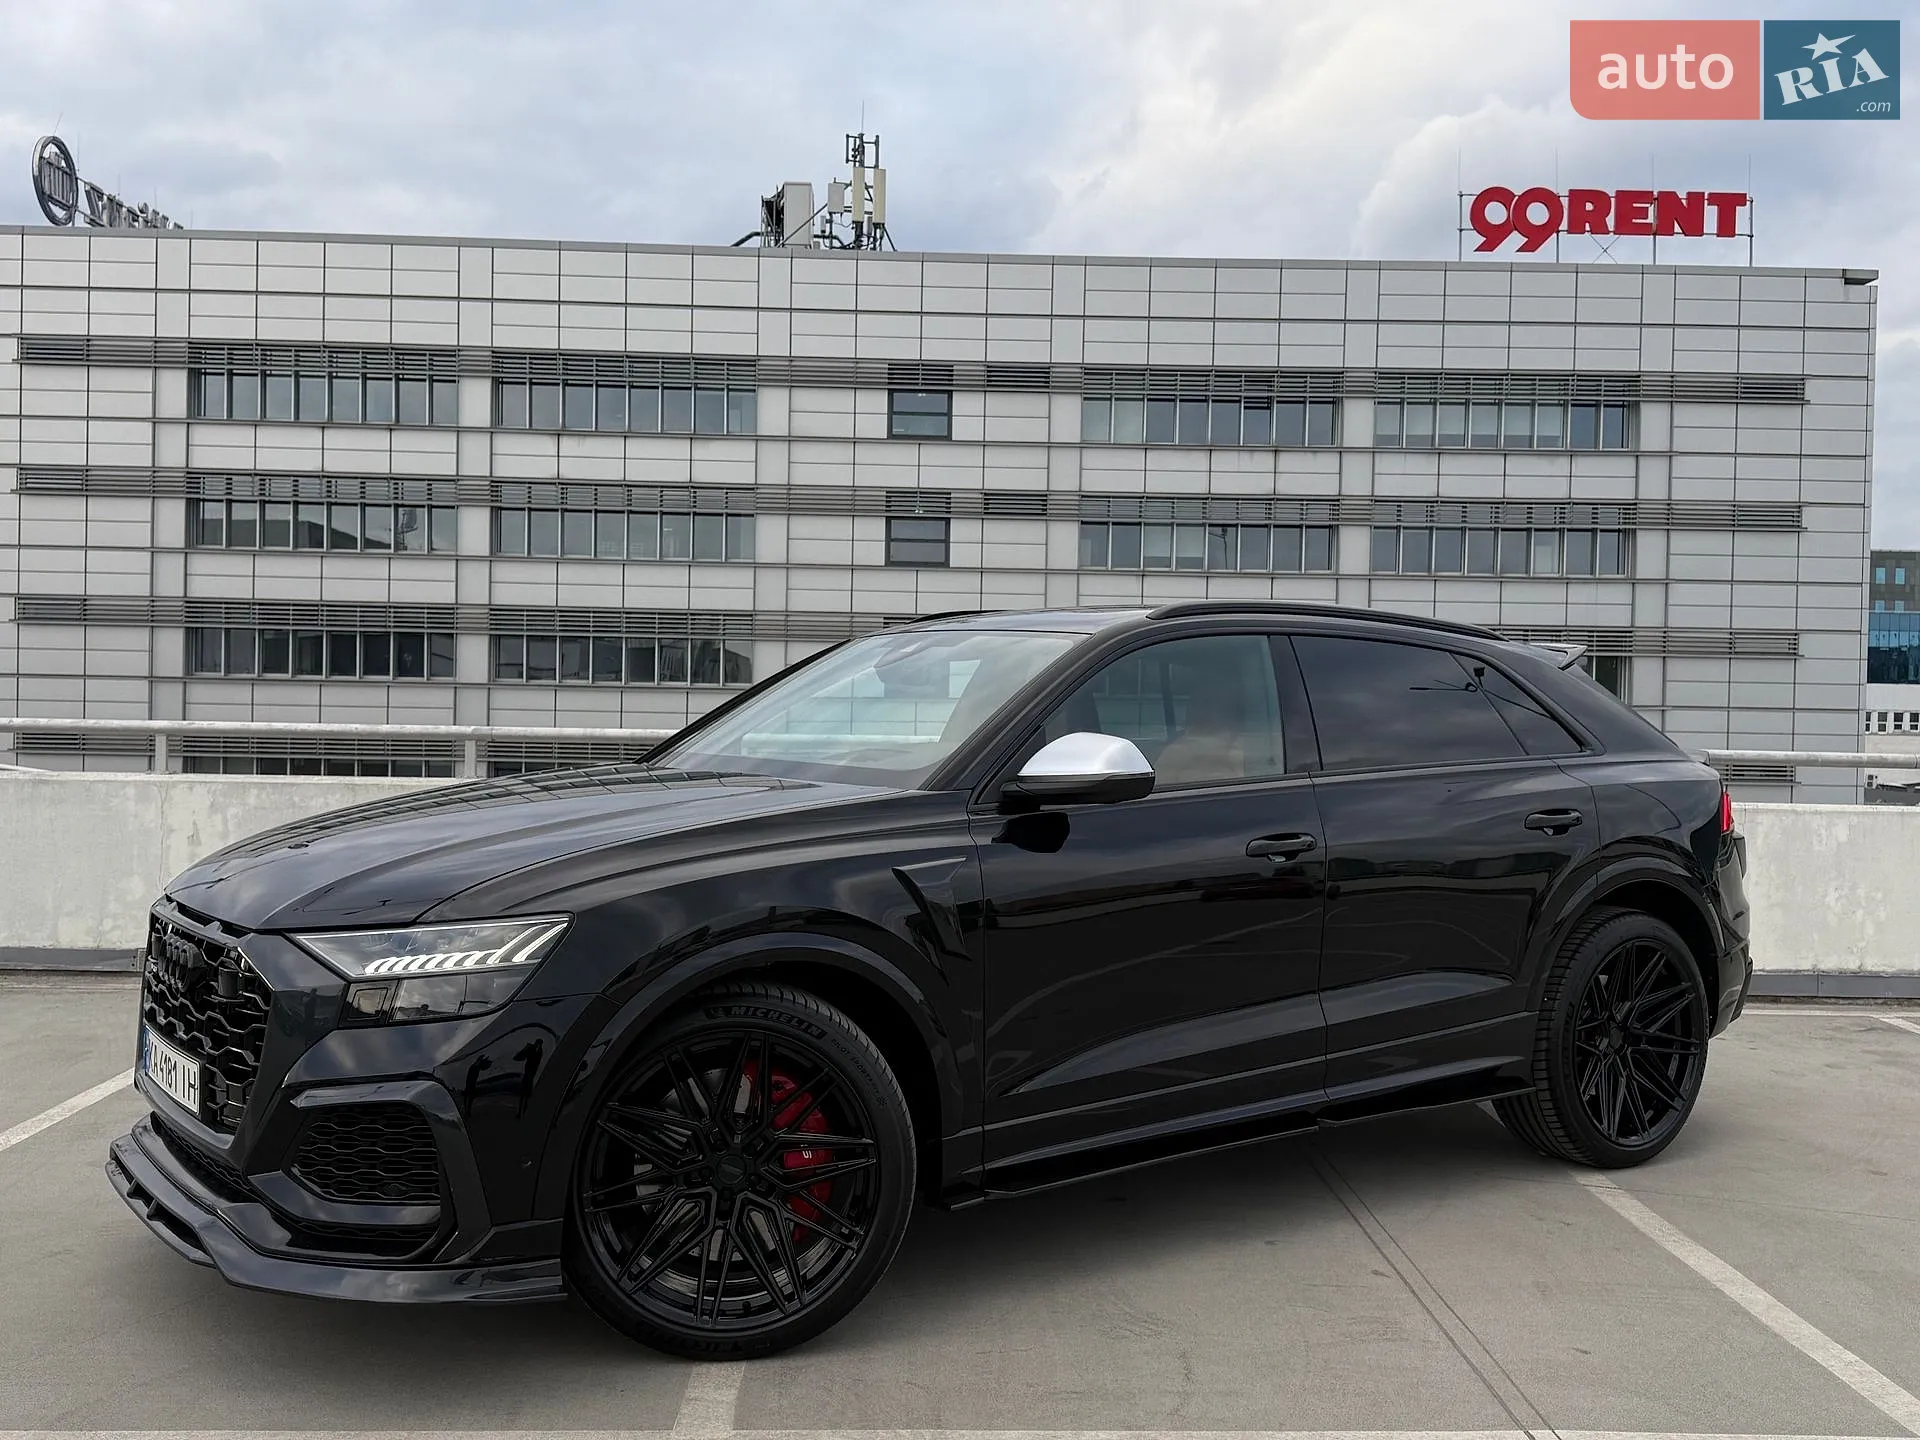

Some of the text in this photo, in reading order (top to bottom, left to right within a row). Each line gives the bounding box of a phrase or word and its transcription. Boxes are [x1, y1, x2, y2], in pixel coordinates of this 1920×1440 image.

[730, 1005, 822, 1039] MICHELIN
[160, 1050, 177, 1093] 4181
[182, 1064, 198, 1105] IH
